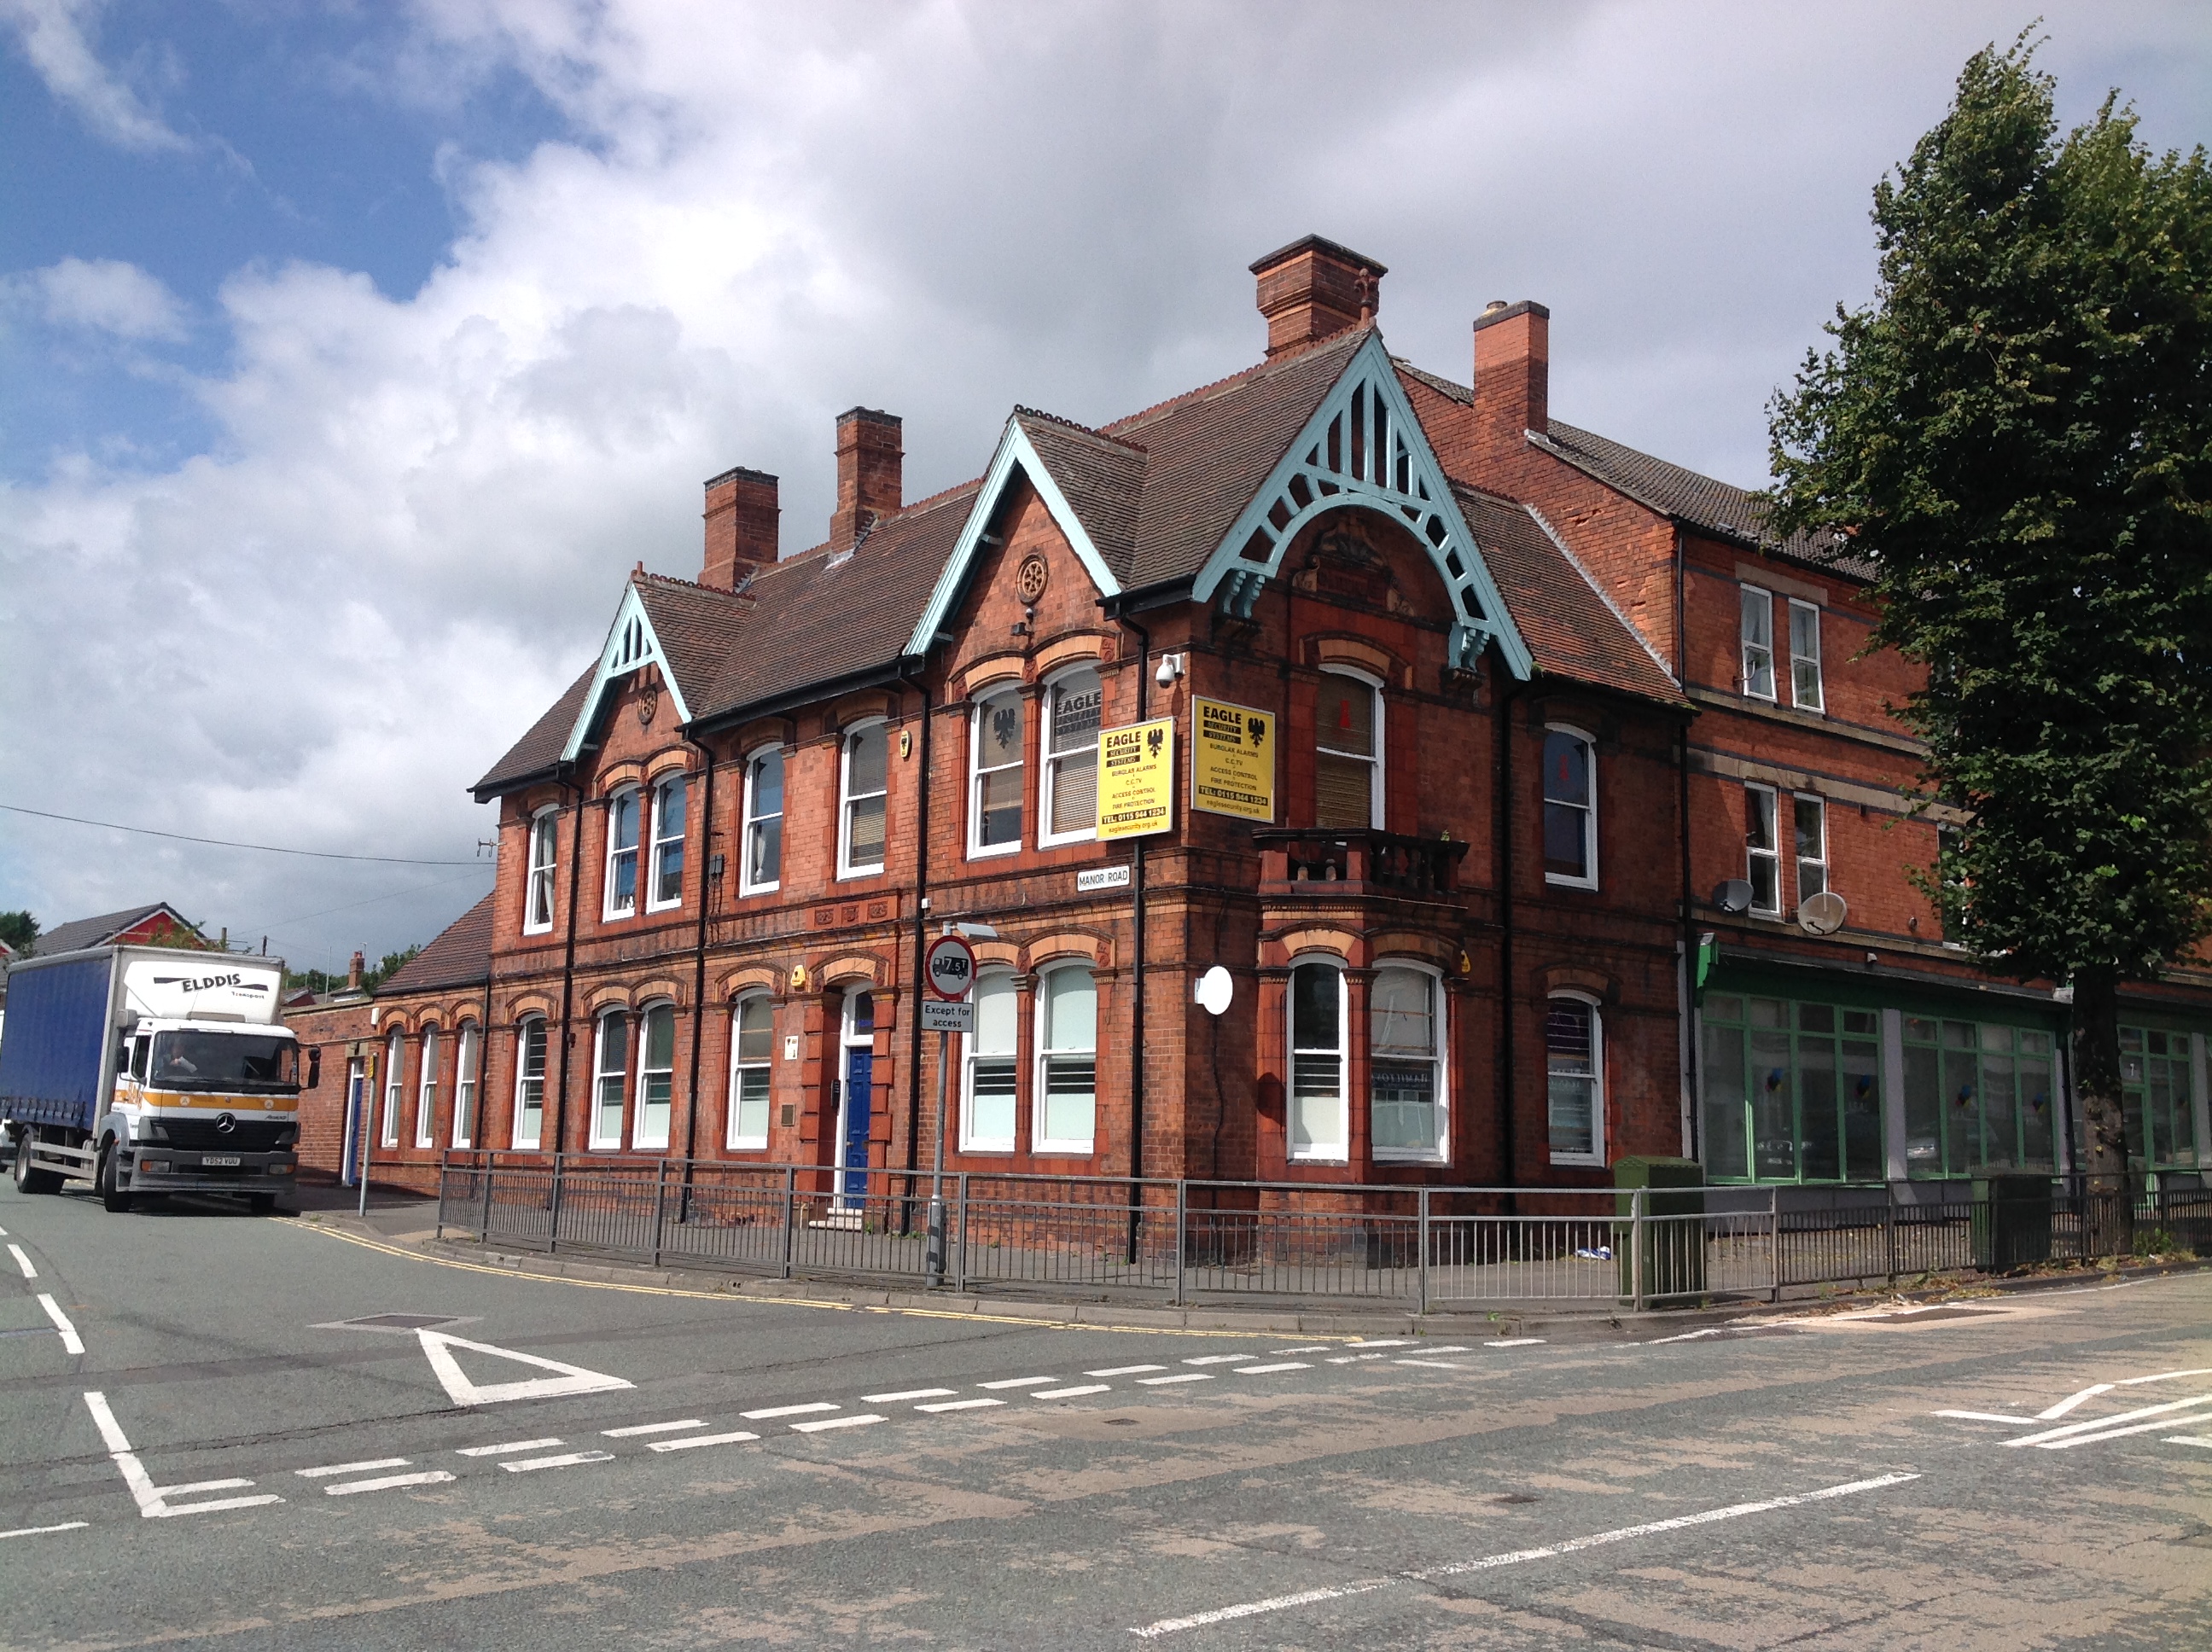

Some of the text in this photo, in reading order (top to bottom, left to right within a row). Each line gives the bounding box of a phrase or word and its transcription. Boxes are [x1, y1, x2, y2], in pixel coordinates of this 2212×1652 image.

[1057, 692, 1102, 715] EAGLE
[1203, 707, 1242, 724] EAGLE
[1208, 721, 1237, 733] SECURITY
[1107, 731, 1141, 747] EAGLE
[1208, 731, 1236, 742] SYSTEMS
[1109, 746, 1137, 756] SECURITY
[1210, 743, 1258, 758] BURGLAR ALARMS
[1111, 756, 1136, 767] SYSTEMS
[1112, 765, 1156, 777] BURGLAR ALARMS
[1210, 766, 1257, 780] ACCESS CONTROL
[1132, 787, 1155, 795] CONTROL
[1224, 780, 1256, 790] PROTECTION
[1200, 786, 1266, 805] TEL: 0115 944 1234
[1124, 799, 1155, 808] PROTECTION
[1103, 808, 1164, 823] TEL: 0115 944 1234
[1080, 870, 1127, 887] MANOR ROAD
[182, 974, 241, 993] ELDDIS
[925, 1005, 970, 1016] Except for
[933, 1019, 962, 1027] access
